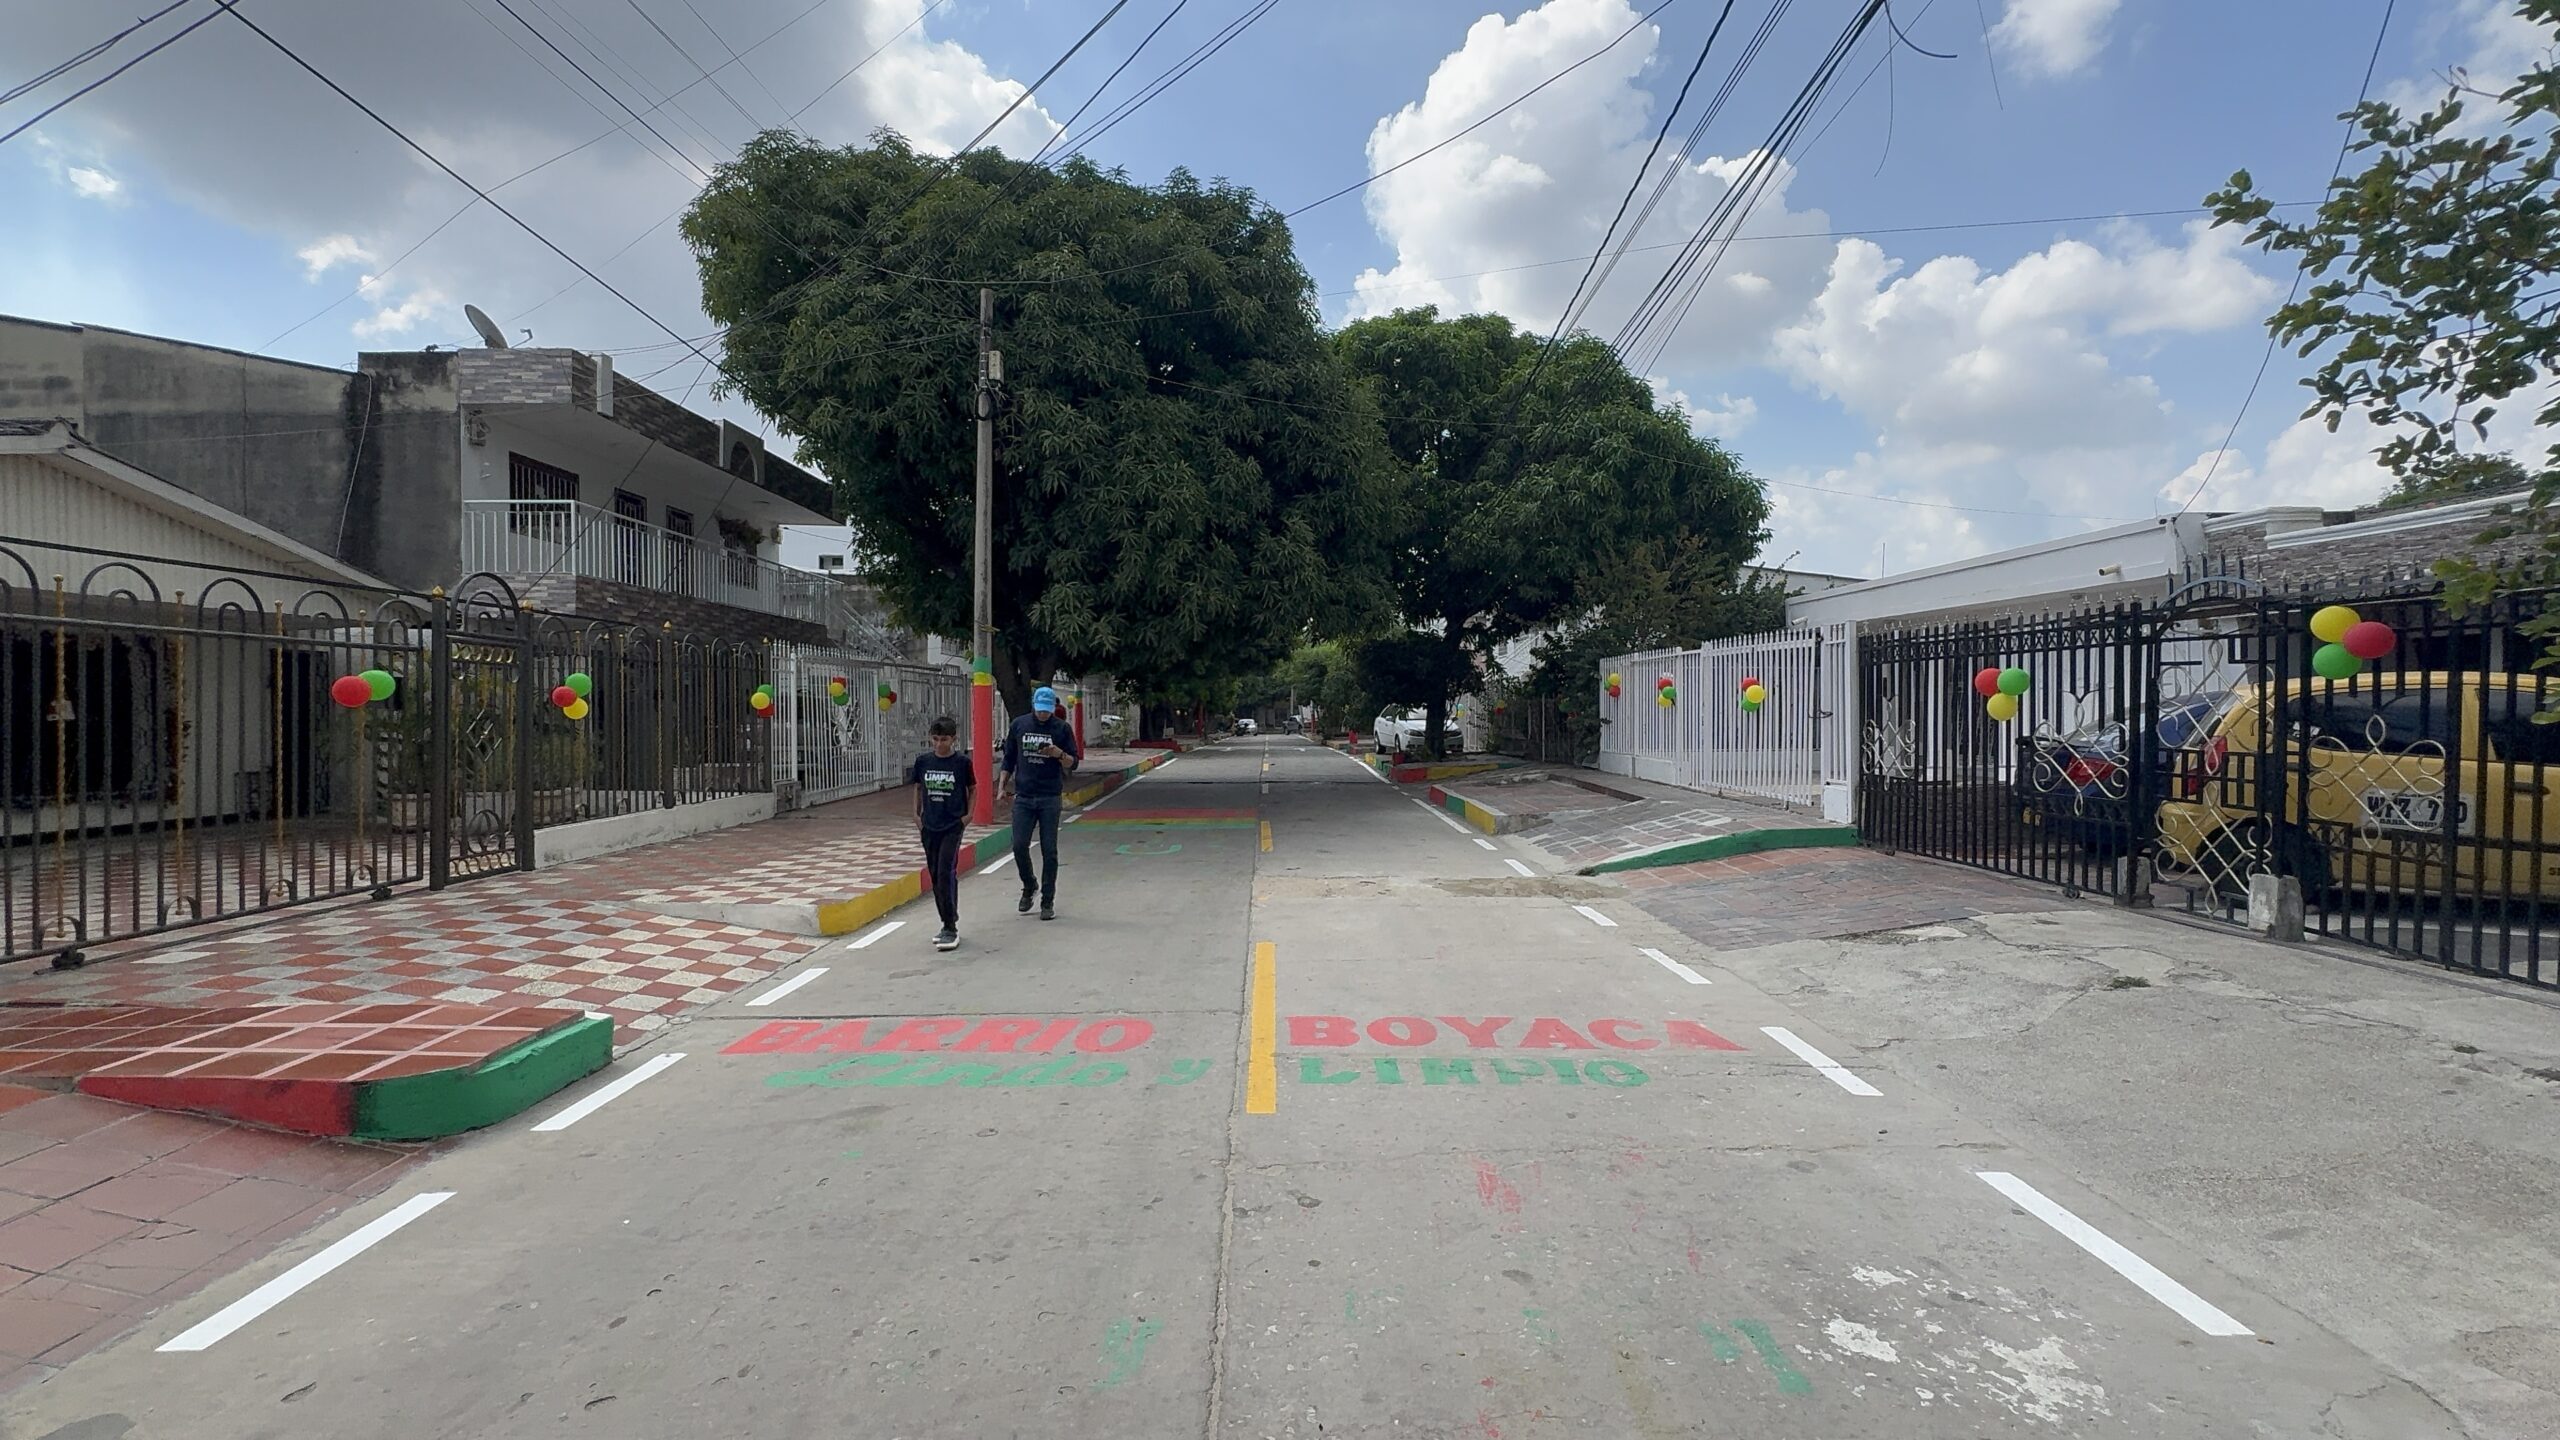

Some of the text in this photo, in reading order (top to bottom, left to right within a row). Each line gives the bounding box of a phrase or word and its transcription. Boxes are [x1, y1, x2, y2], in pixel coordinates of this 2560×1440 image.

[718, 1015, 1750, 1056] BARRIO BOYACA
[1299, 1056, 1652, 1089] LIMPIO
